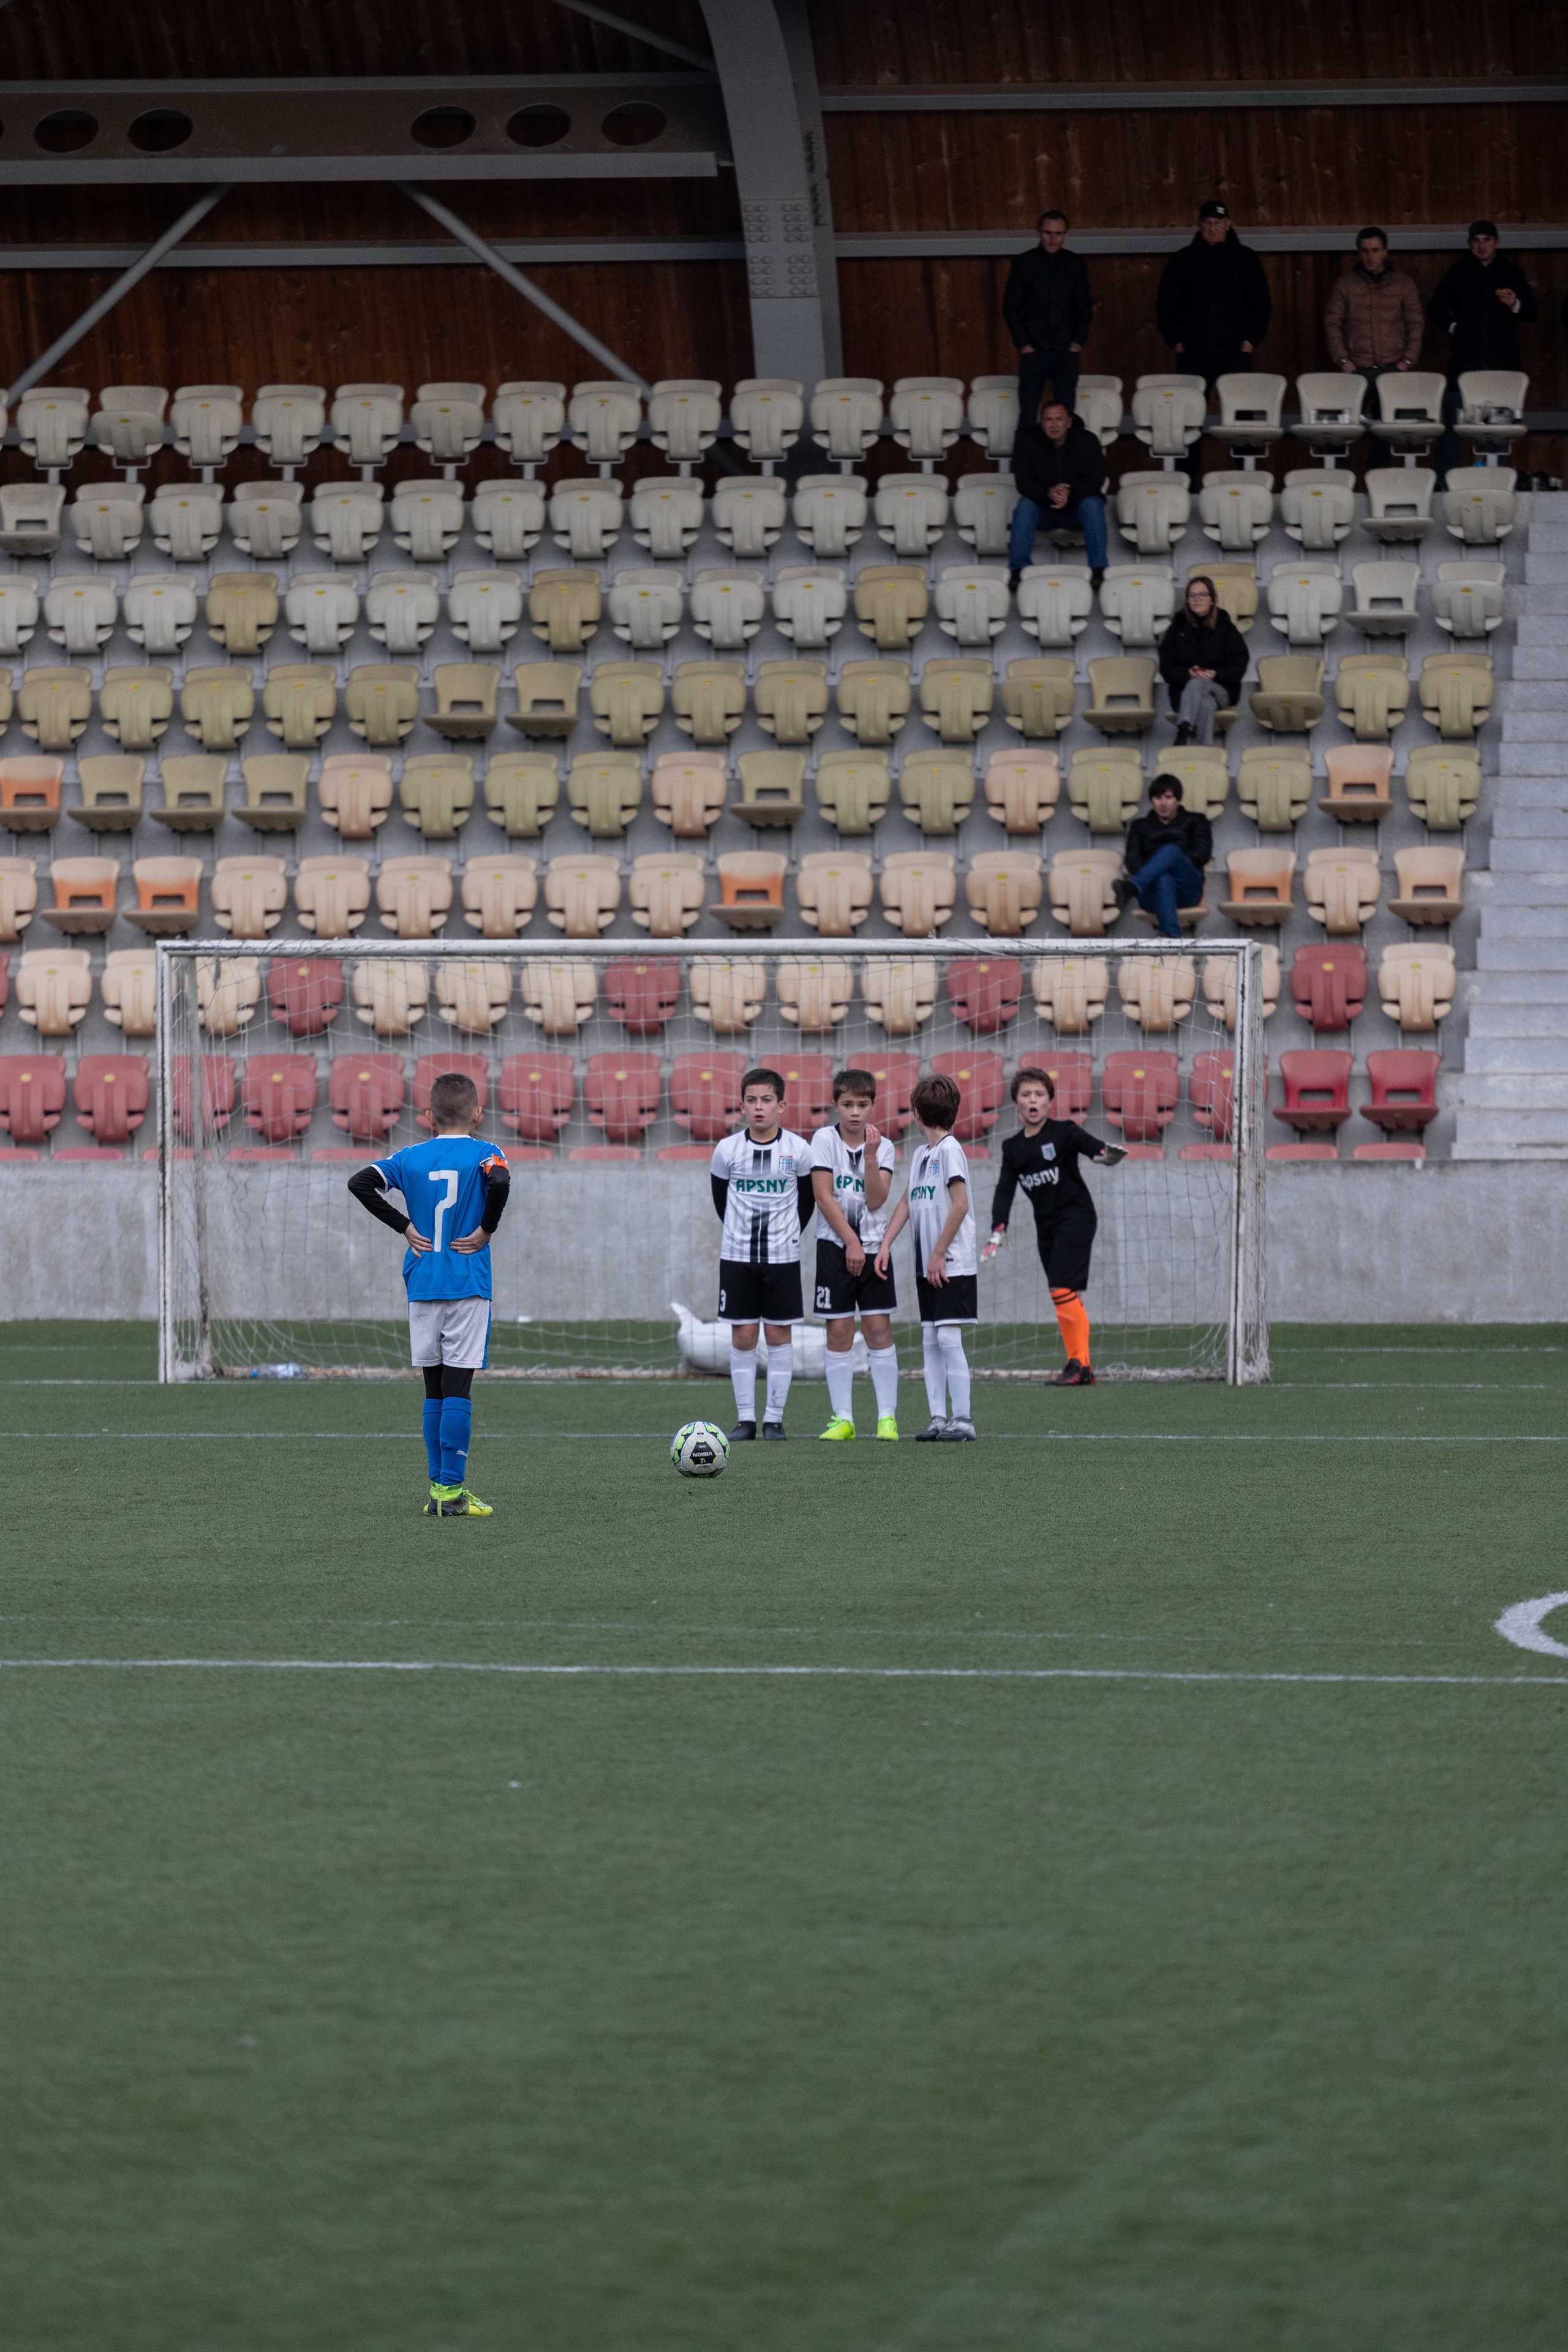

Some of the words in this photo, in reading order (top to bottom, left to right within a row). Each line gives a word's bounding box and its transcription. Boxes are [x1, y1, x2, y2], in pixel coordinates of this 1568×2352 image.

[736, 1179, 787, 1193] APSNY
[429, 1170, 458, 1252] 7
[816, 1286, 832, 1309] 21
